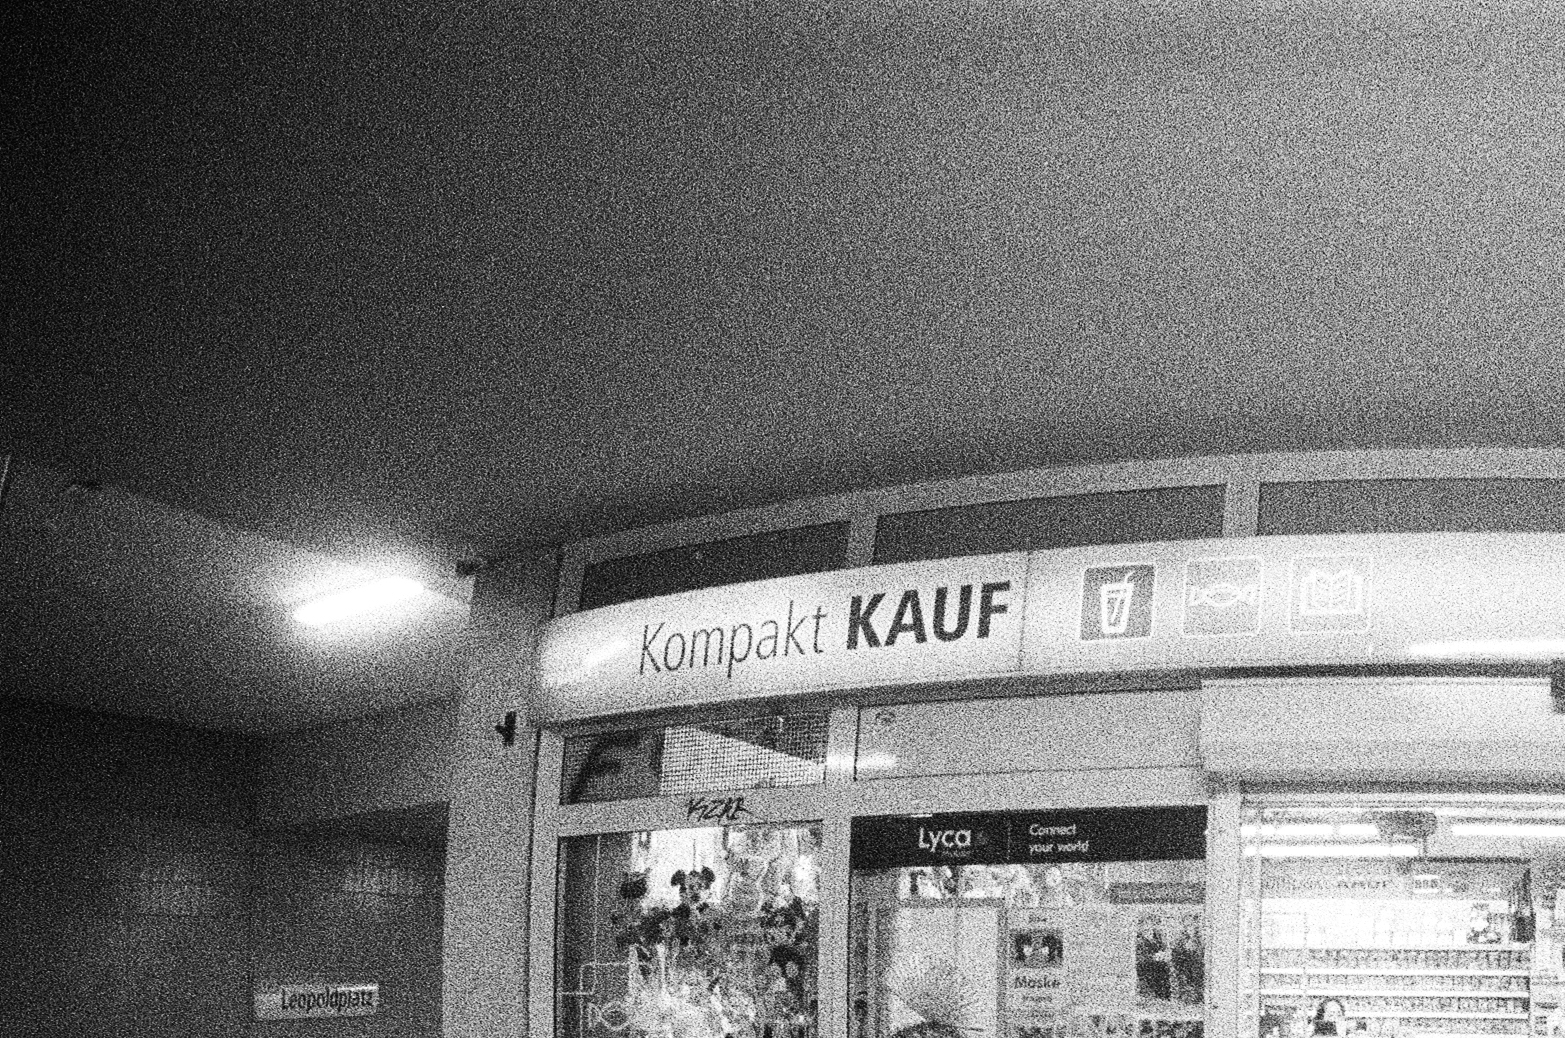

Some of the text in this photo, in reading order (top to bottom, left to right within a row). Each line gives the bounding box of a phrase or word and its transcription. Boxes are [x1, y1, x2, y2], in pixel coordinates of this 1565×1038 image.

[638, 581, 1012, 678] Kompakt KAUF
[917, 826, 972, 851] Lyca
[1028, 823, 1078, 838] Connect
[1028, 838, 1090, 854] your world
